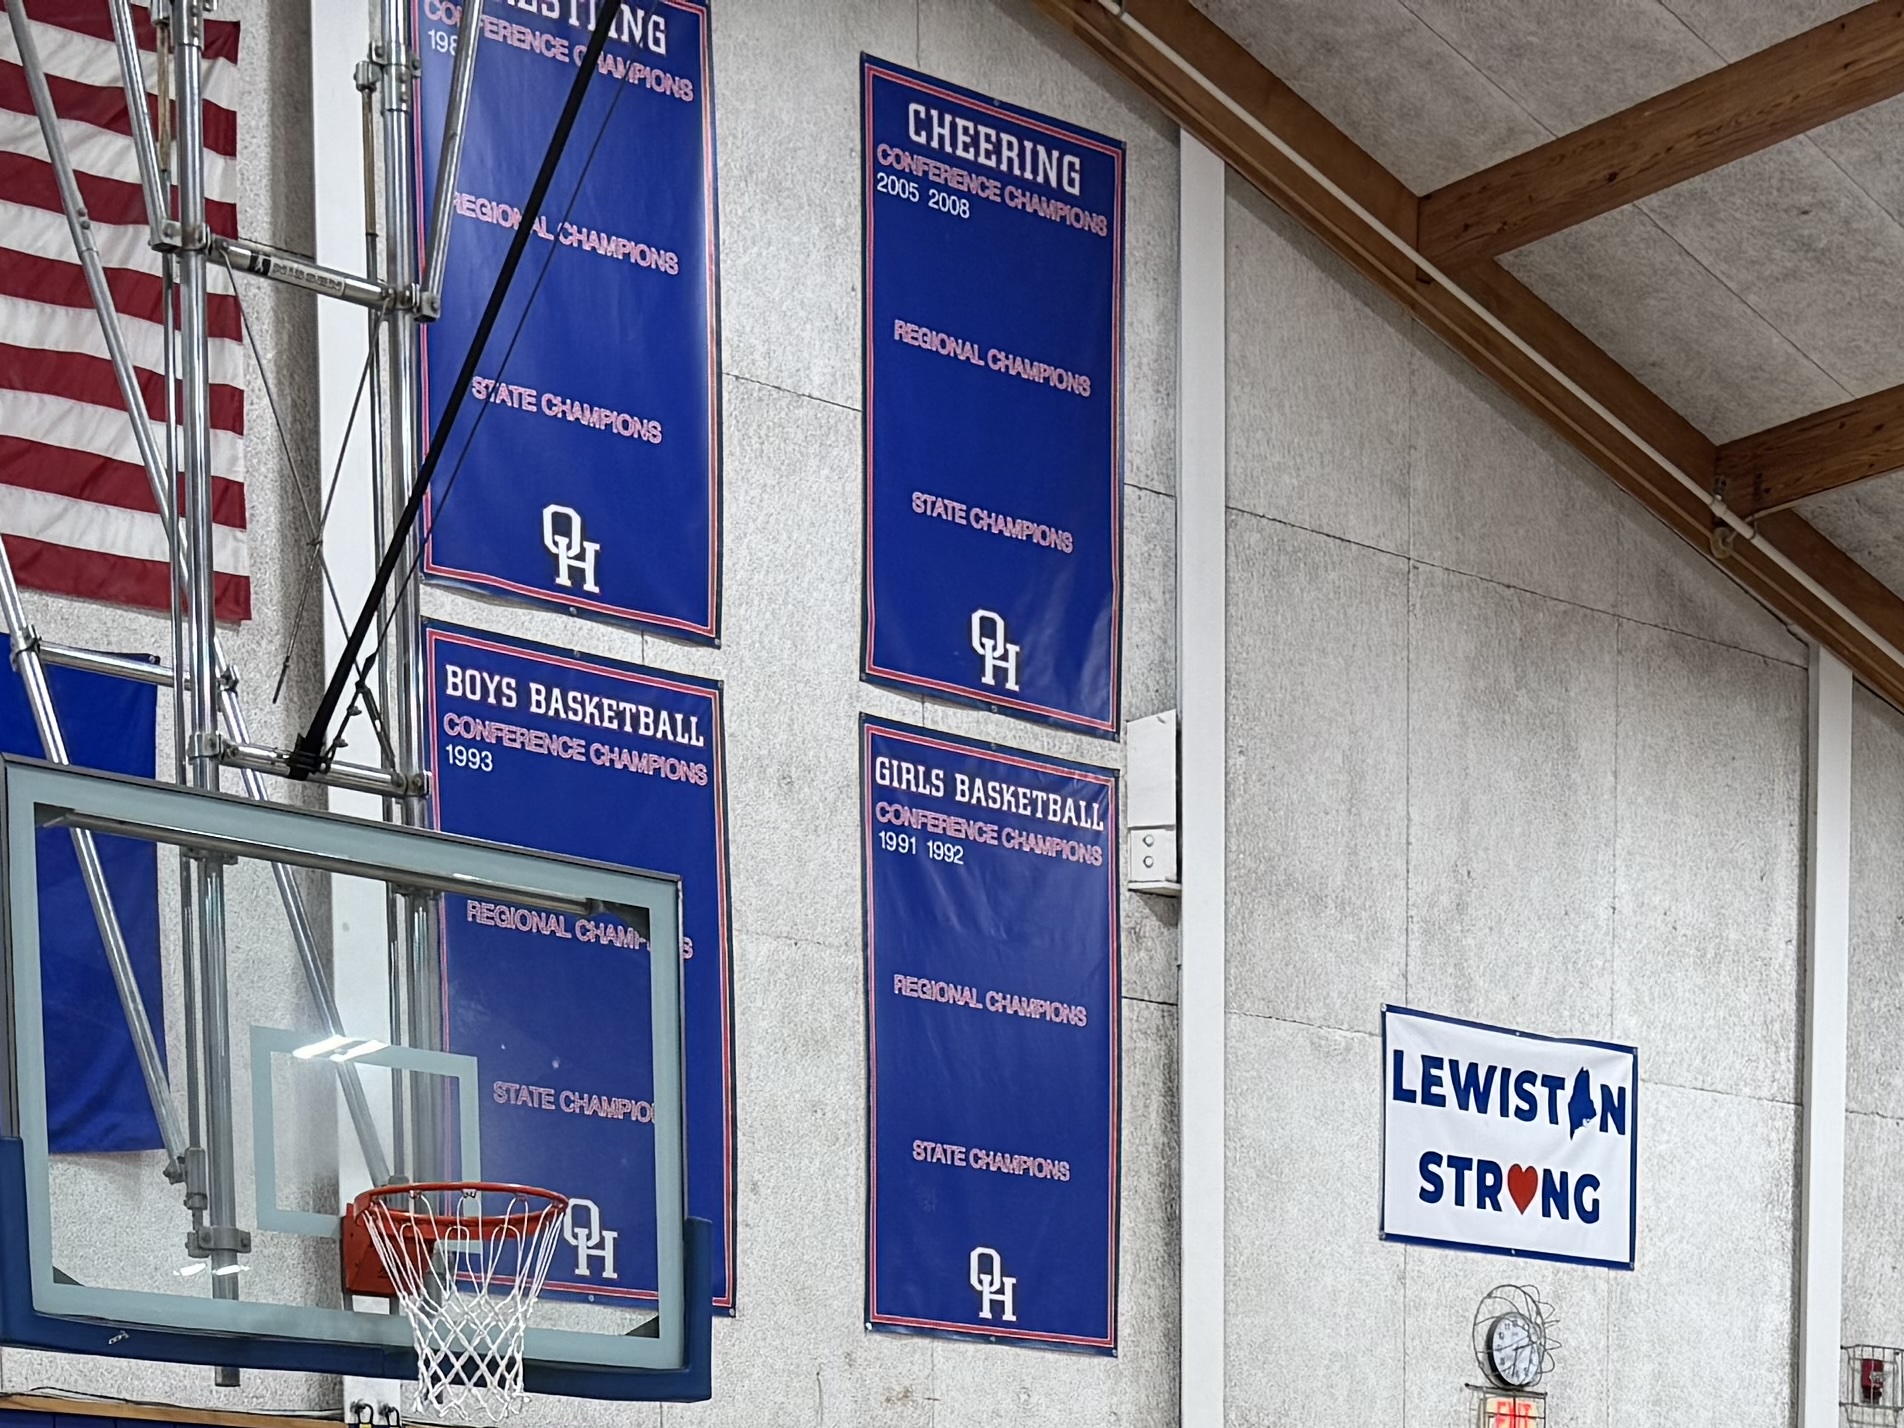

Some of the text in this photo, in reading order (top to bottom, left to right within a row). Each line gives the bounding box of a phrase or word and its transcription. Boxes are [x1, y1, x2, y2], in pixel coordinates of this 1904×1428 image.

[424, 0, 569, 64] COERENCE
[574, 39, 695, 102] CAMPIONS
[908, 102, 1081, 196] CHEERING
[876, 143, 1108, 237] CONFERENCE CHAMPIONS
[877, 173, 970, 219] 2005 2008
[558, 222, 679, 275] CHAMPIONS
[894, 319, 1091, 397] REGIONAL CHAMPIONS
[471, 376, 662, 444] STATE CHAMPIONS
[911, 491, 1074, 555] STATE CHAMPIONS
[971, 608, 1020, 692] OH
[446, 664, 704, 747] BOYS BASKETBALL
[443, 712, 708, 786] CONFERENCE CHAMPIONS
[446, 744, 493, 772] 1993
[875, 756, 1104, 831] GIRLS BASKETBALL
[875, 801, 1103, 867] CONFERENCE CHAMPIONS
[879, 831, 964, 865] 1991 1992
[467, 900, 694, 960] REGIONAL CHAMPS
[893, 973, 1087, 1028] REGIONAL CHAMPIONS
[493, 1081, 656, 1124] STATE CHAMPIO
[1392, 1048, 1626, 1139] LEWISTN
[912, 1139, 1070, 1183] STATE CHAMPIONS
[1419, 1150, 1600, 1225] STRNG
[969, 1246, 1016, 1322] OH
